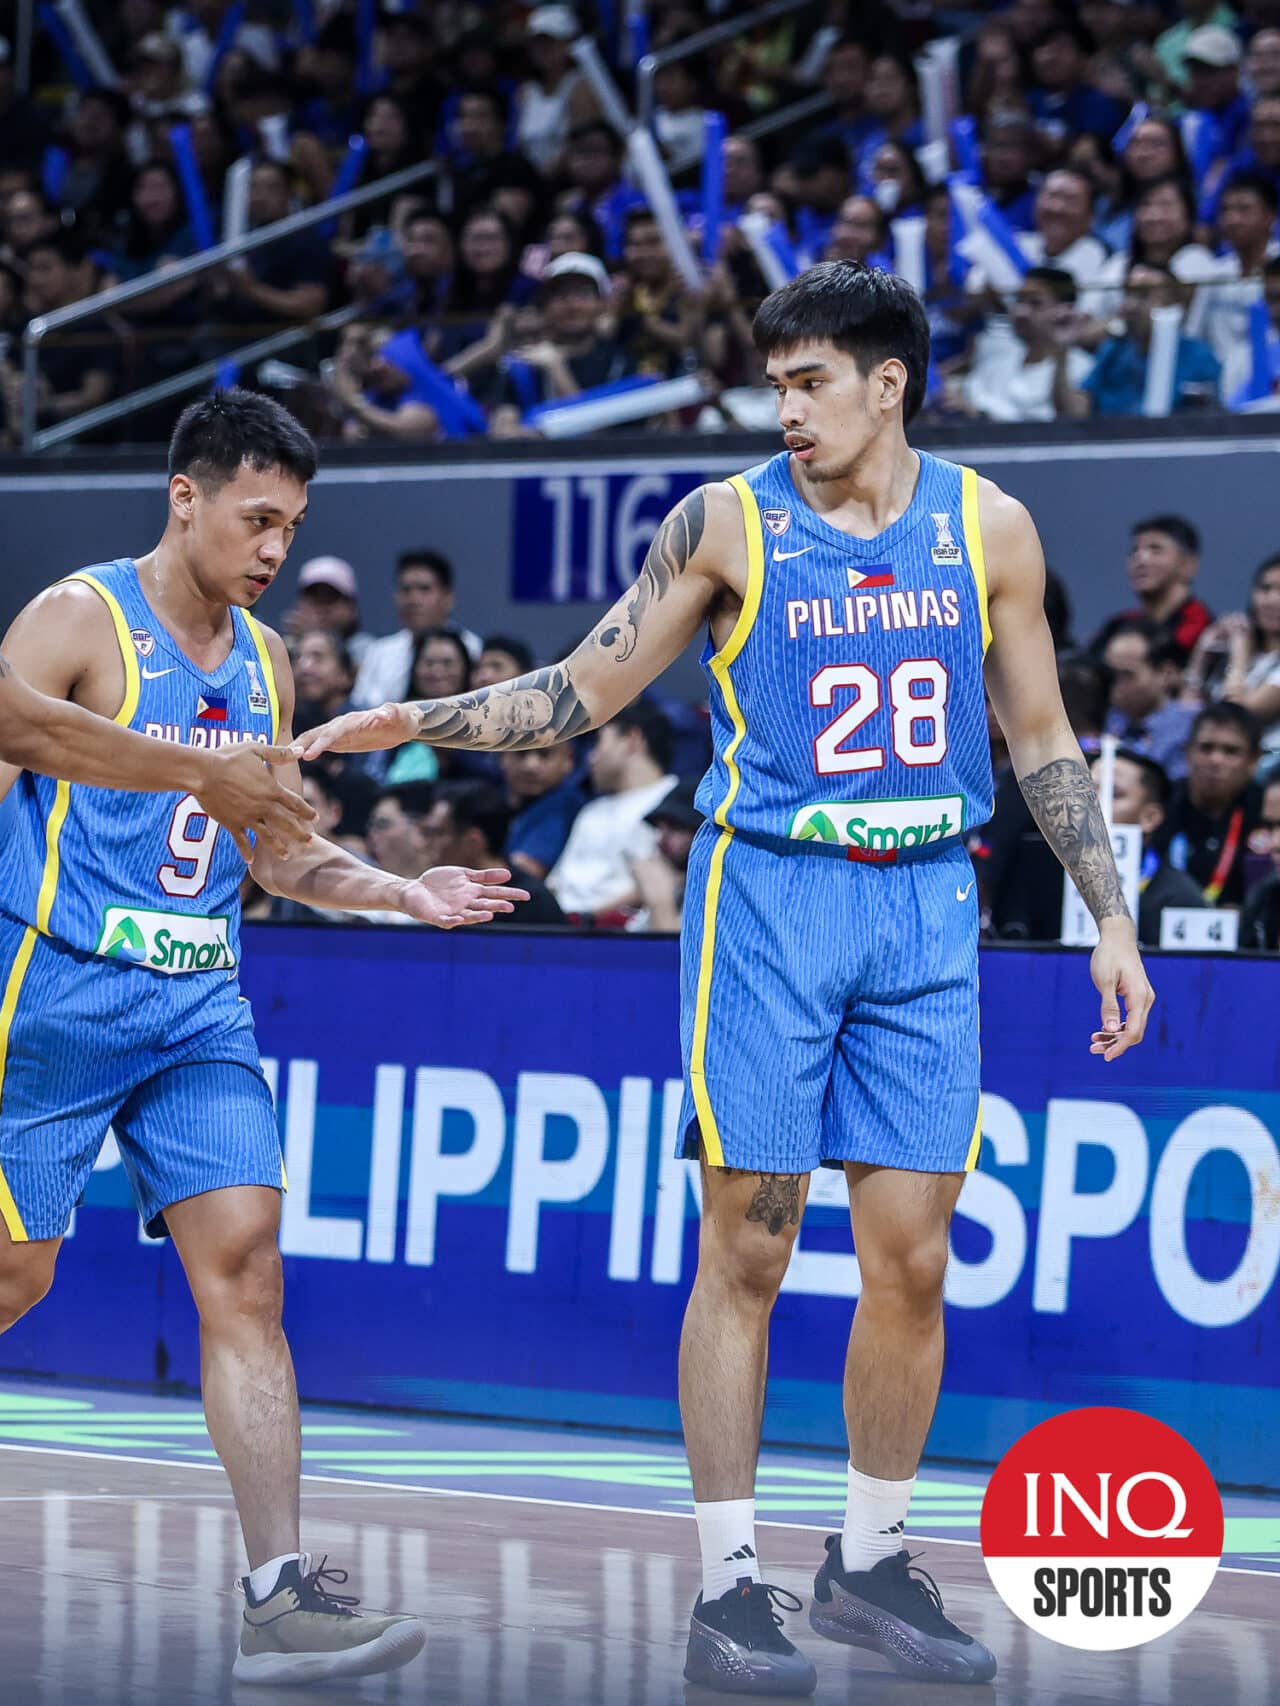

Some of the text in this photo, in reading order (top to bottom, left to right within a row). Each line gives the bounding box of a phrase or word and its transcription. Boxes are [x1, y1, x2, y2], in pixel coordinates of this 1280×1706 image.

[542, 472, 669, 602] 116
[786, 588, 961, 640] PILIPINAS
[808, 657, 950, 776] 28
[156, 792, 221, 899] 9
[845, 813, 954, 850] Smart
[942, 1091, 1280, 1329] SPO
